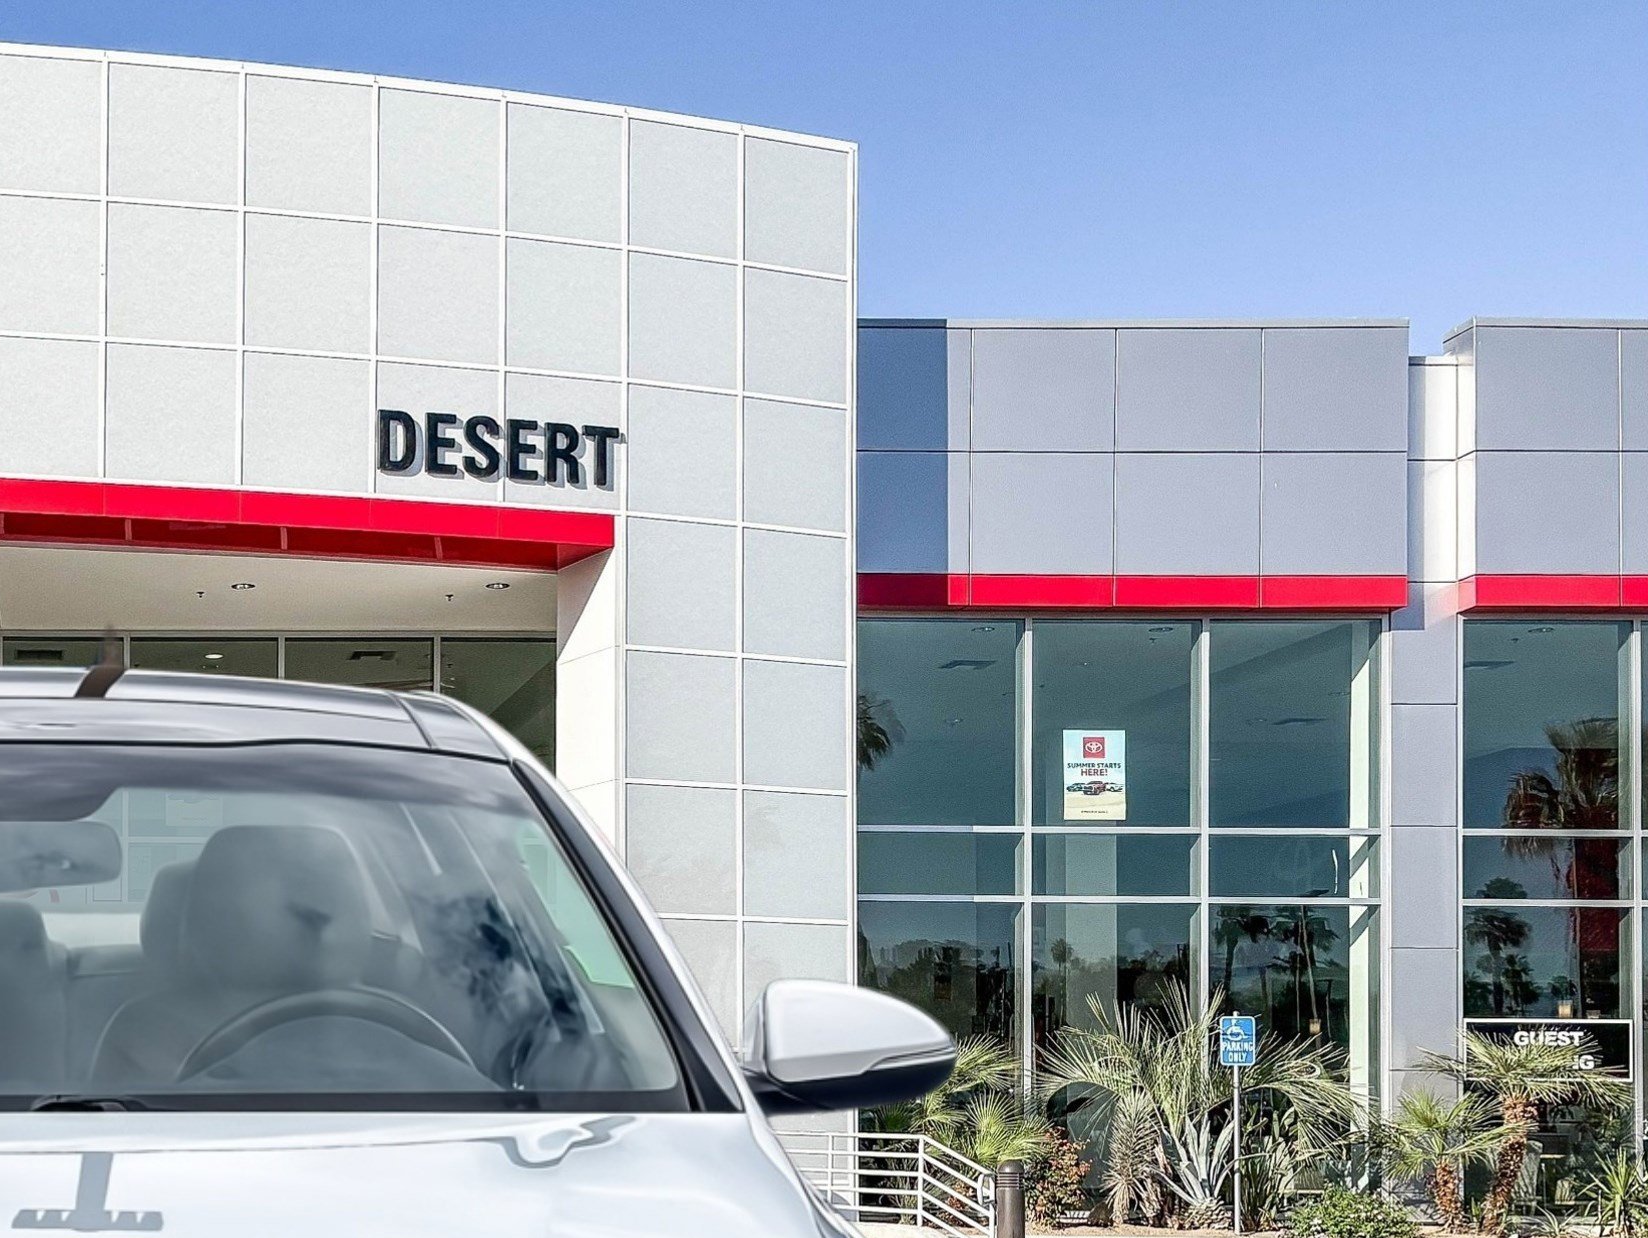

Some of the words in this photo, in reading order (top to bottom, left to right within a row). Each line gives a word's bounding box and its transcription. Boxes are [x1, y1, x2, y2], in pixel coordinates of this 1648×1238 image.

[376, 409, 620, 487] DESERT
[1080, 768, 1109, 777] HERE!
[1513, 1030, 1585, 1047] GUEST
[1221, 1040, 1254, 1052] PARKING
[1228, 1051, 1248, 1063] ONLY
